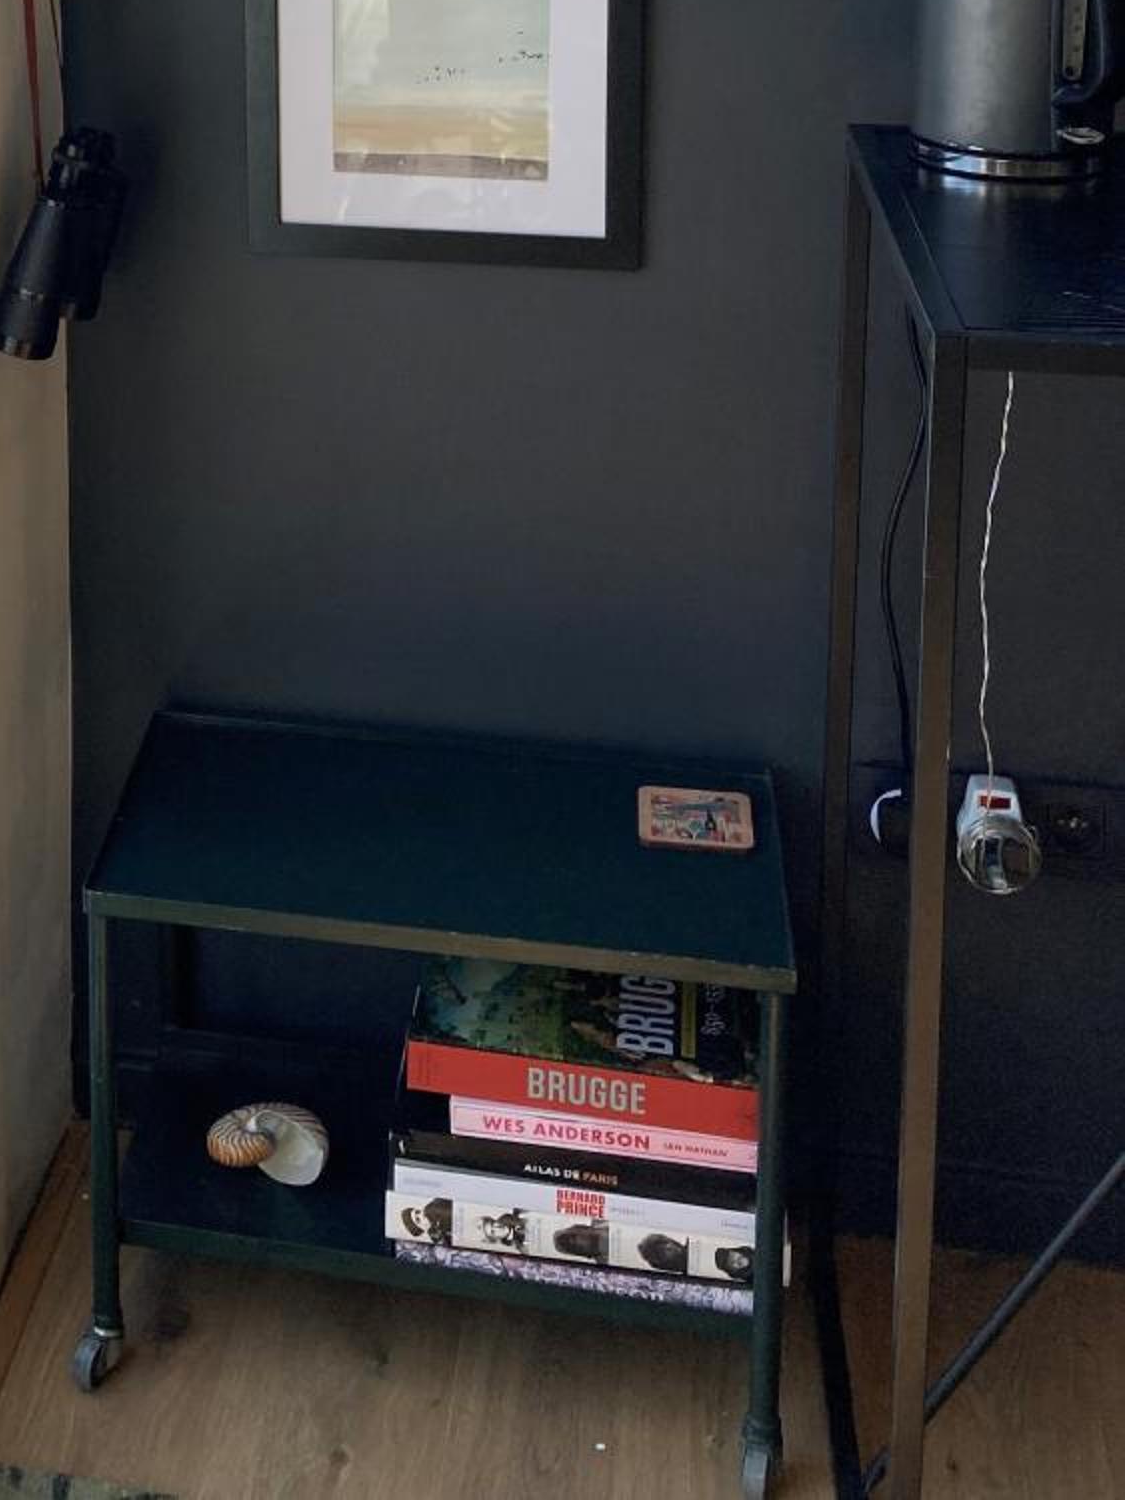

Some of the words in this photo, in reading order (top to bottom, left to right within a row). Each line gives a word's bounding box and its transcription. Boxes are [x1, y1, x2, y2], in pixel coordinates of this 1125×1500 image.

[528, 1067, 646, 1115] BRUGGE
[482, 1115, 524, 1133] WES
[533, 1122, 650, 1150] ANDERSON
[524, 1164, 561, 1177] ATLAS
[582, 1171, 618, 1185] PARIS
[556, 1189, 606, 1204] BERNARD
[556, 1201, 604, 1218] PRINCE
